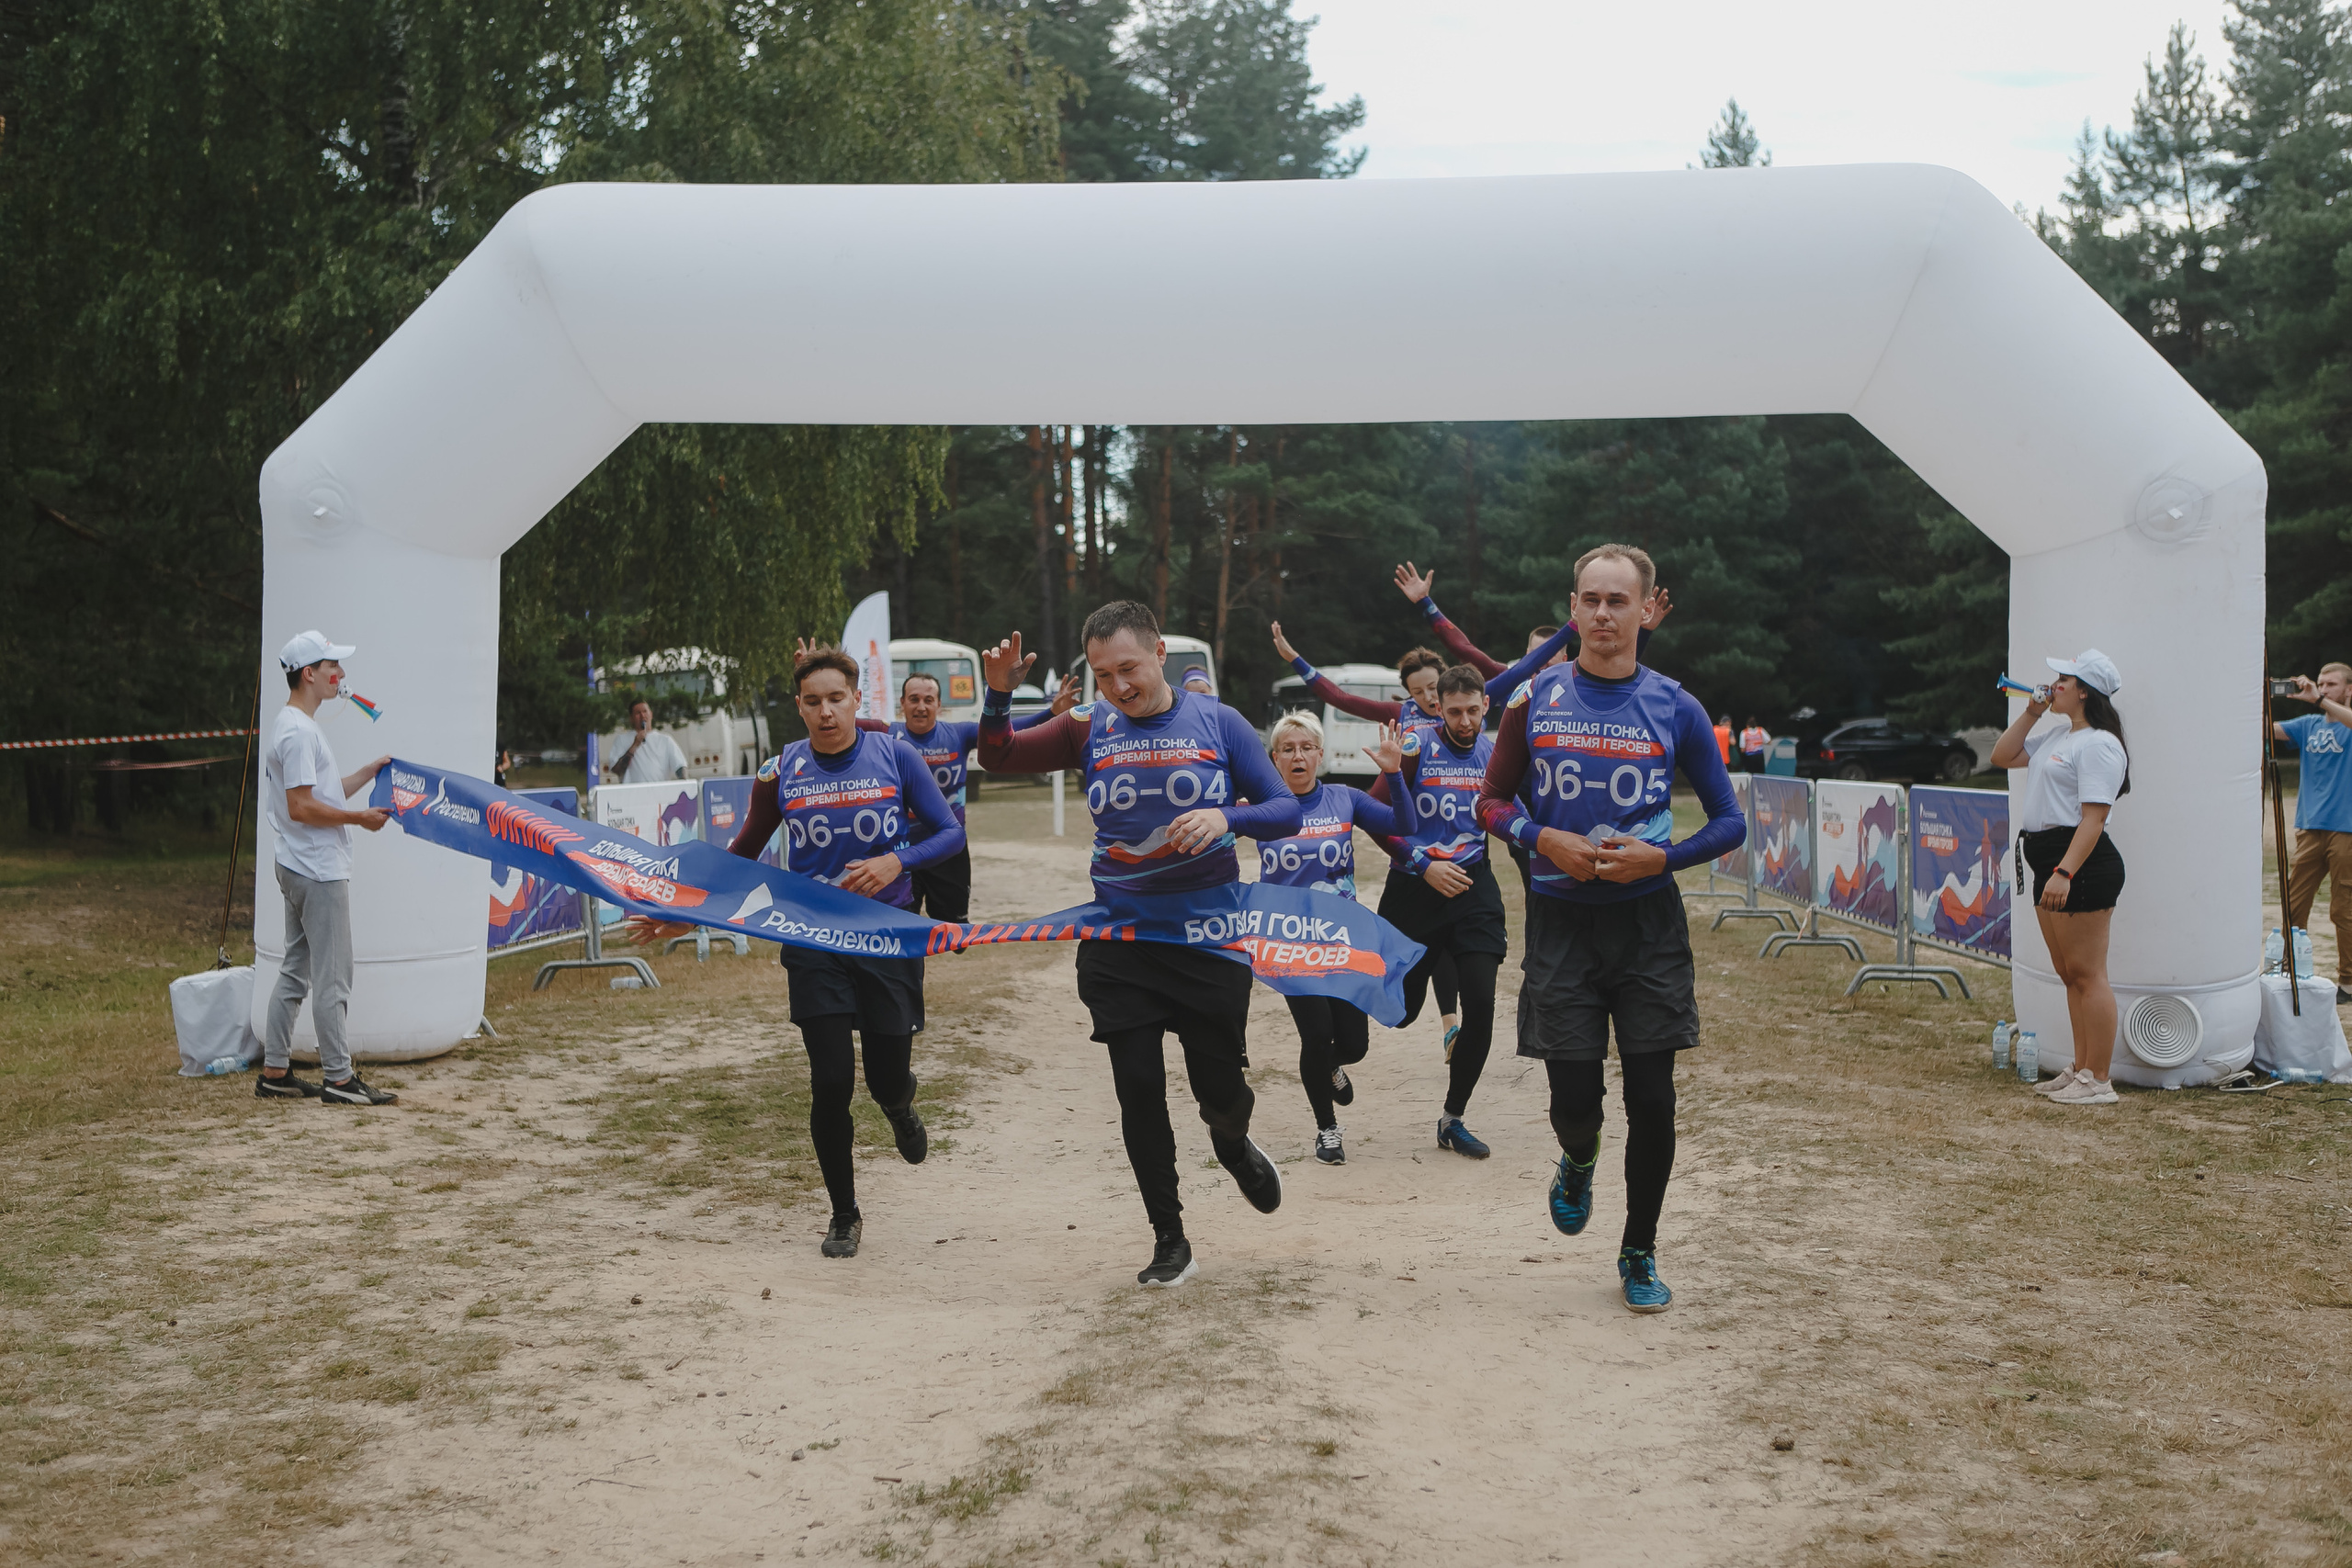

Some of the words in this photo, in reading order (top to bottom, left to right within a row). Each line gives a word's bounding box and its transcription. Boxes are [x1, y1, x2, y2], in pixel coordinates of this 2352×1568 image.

[1535, 709, 1573, 717] Ростелеком
[1532, 721, 1600, 735] БОЛЬШАЯ
[1603, 724, 1651, 741] ГОНКА
[923, 748, 950, 756] ГОНКА
[1092, 739, 1149, 760] БОЛЬШАЯ
[1152, 738, 1198, 750] ГОНКА
[1556, 735, 1600, 749] ВРЕМЯ
[1602, 739, 1652, 754] ГЕРОЕВ
[1113, 750, 1151, 765] ВРЕМЯ
[1154, 750, 1201, 761] ГЕРОЕВ
[1421, 767, 1464, 777] БОЛЬШАЯ
[1440, 777, 1464, 786] ВРЕМЯ
[1534, 757, 1668, 807] 06-05
[783, 782, 837, 799] БОЛЬШАЯ
[841, 777, 881, 791] ГОНКА
[805, 791, 841, 807] ВРЕМЯ
[842, 788, 883, 803] ГЕРОЕВ
[1088, 769, 1228, 816] 06-04
[486, 800, 586, 856] ФИНИШ
[788, 805, 900, 849] 06-06
[1308, 816, 1340, 827] ГОНКА
[1309, 824, 1343, 835] ГЕРОЕВ
[1262, 839, 1352, 875] 06-09
[759, 909, 901, 956] Ростелеком
[1266, 912, 1351, 946] ГОНКА
[1261, 941, 1351, 967] ГЕРОЕВ
